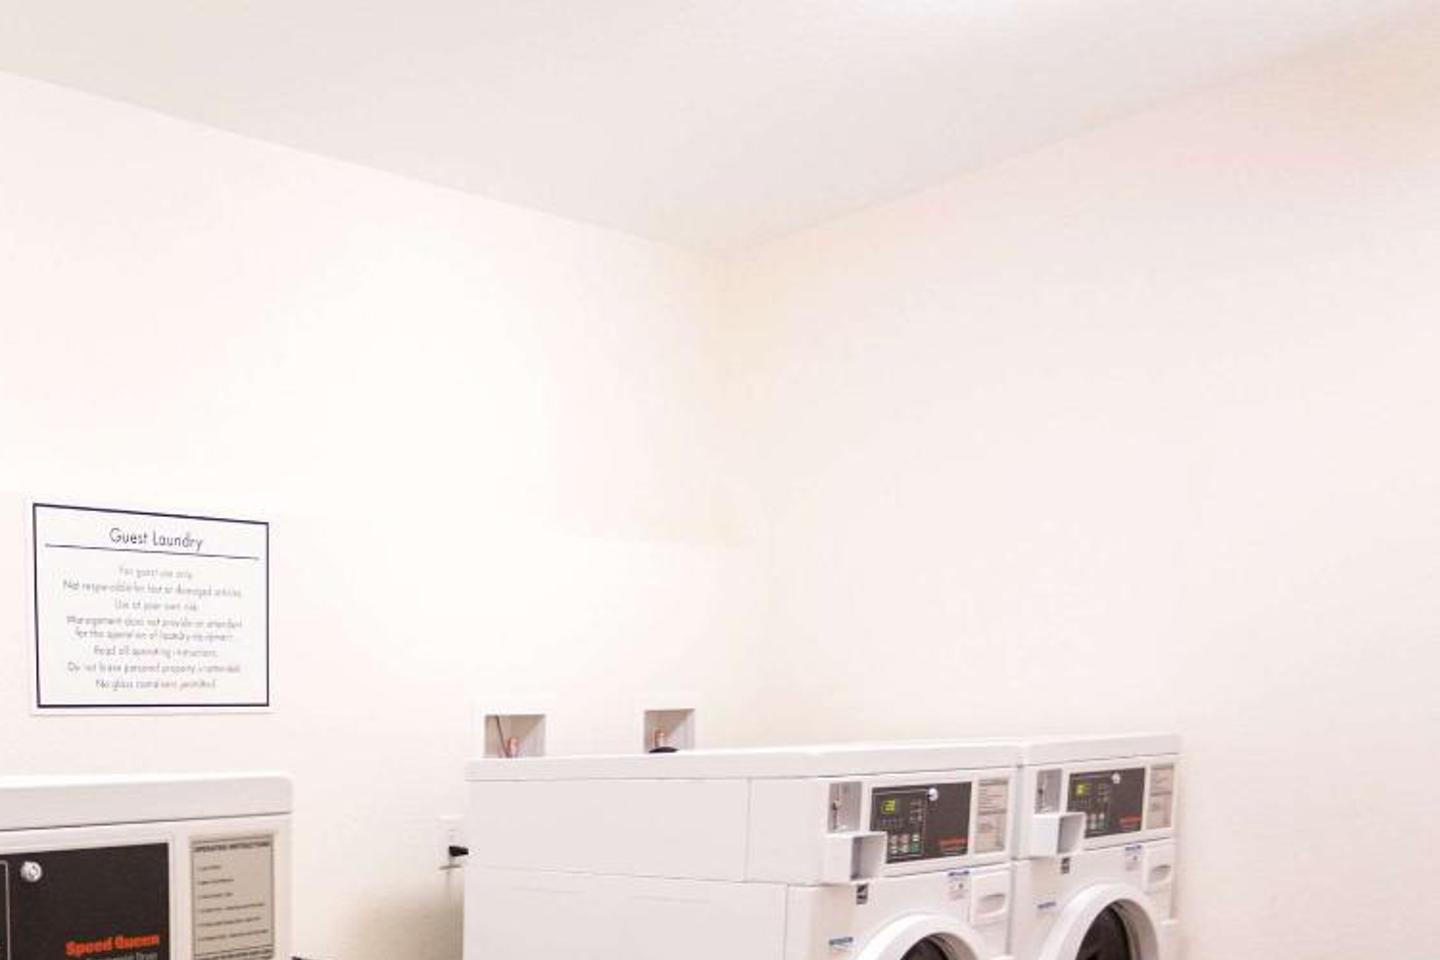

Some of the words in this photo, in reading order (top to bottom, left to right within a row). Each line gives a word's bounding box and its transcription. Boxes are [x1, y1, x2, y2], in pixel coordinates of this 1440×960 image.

[109, 527, 148, 545] Guest
[153, 530, 204, 553] Laundry
[64, 936, 113, 959] Speed
[114, 934, 160, 951] Queen
